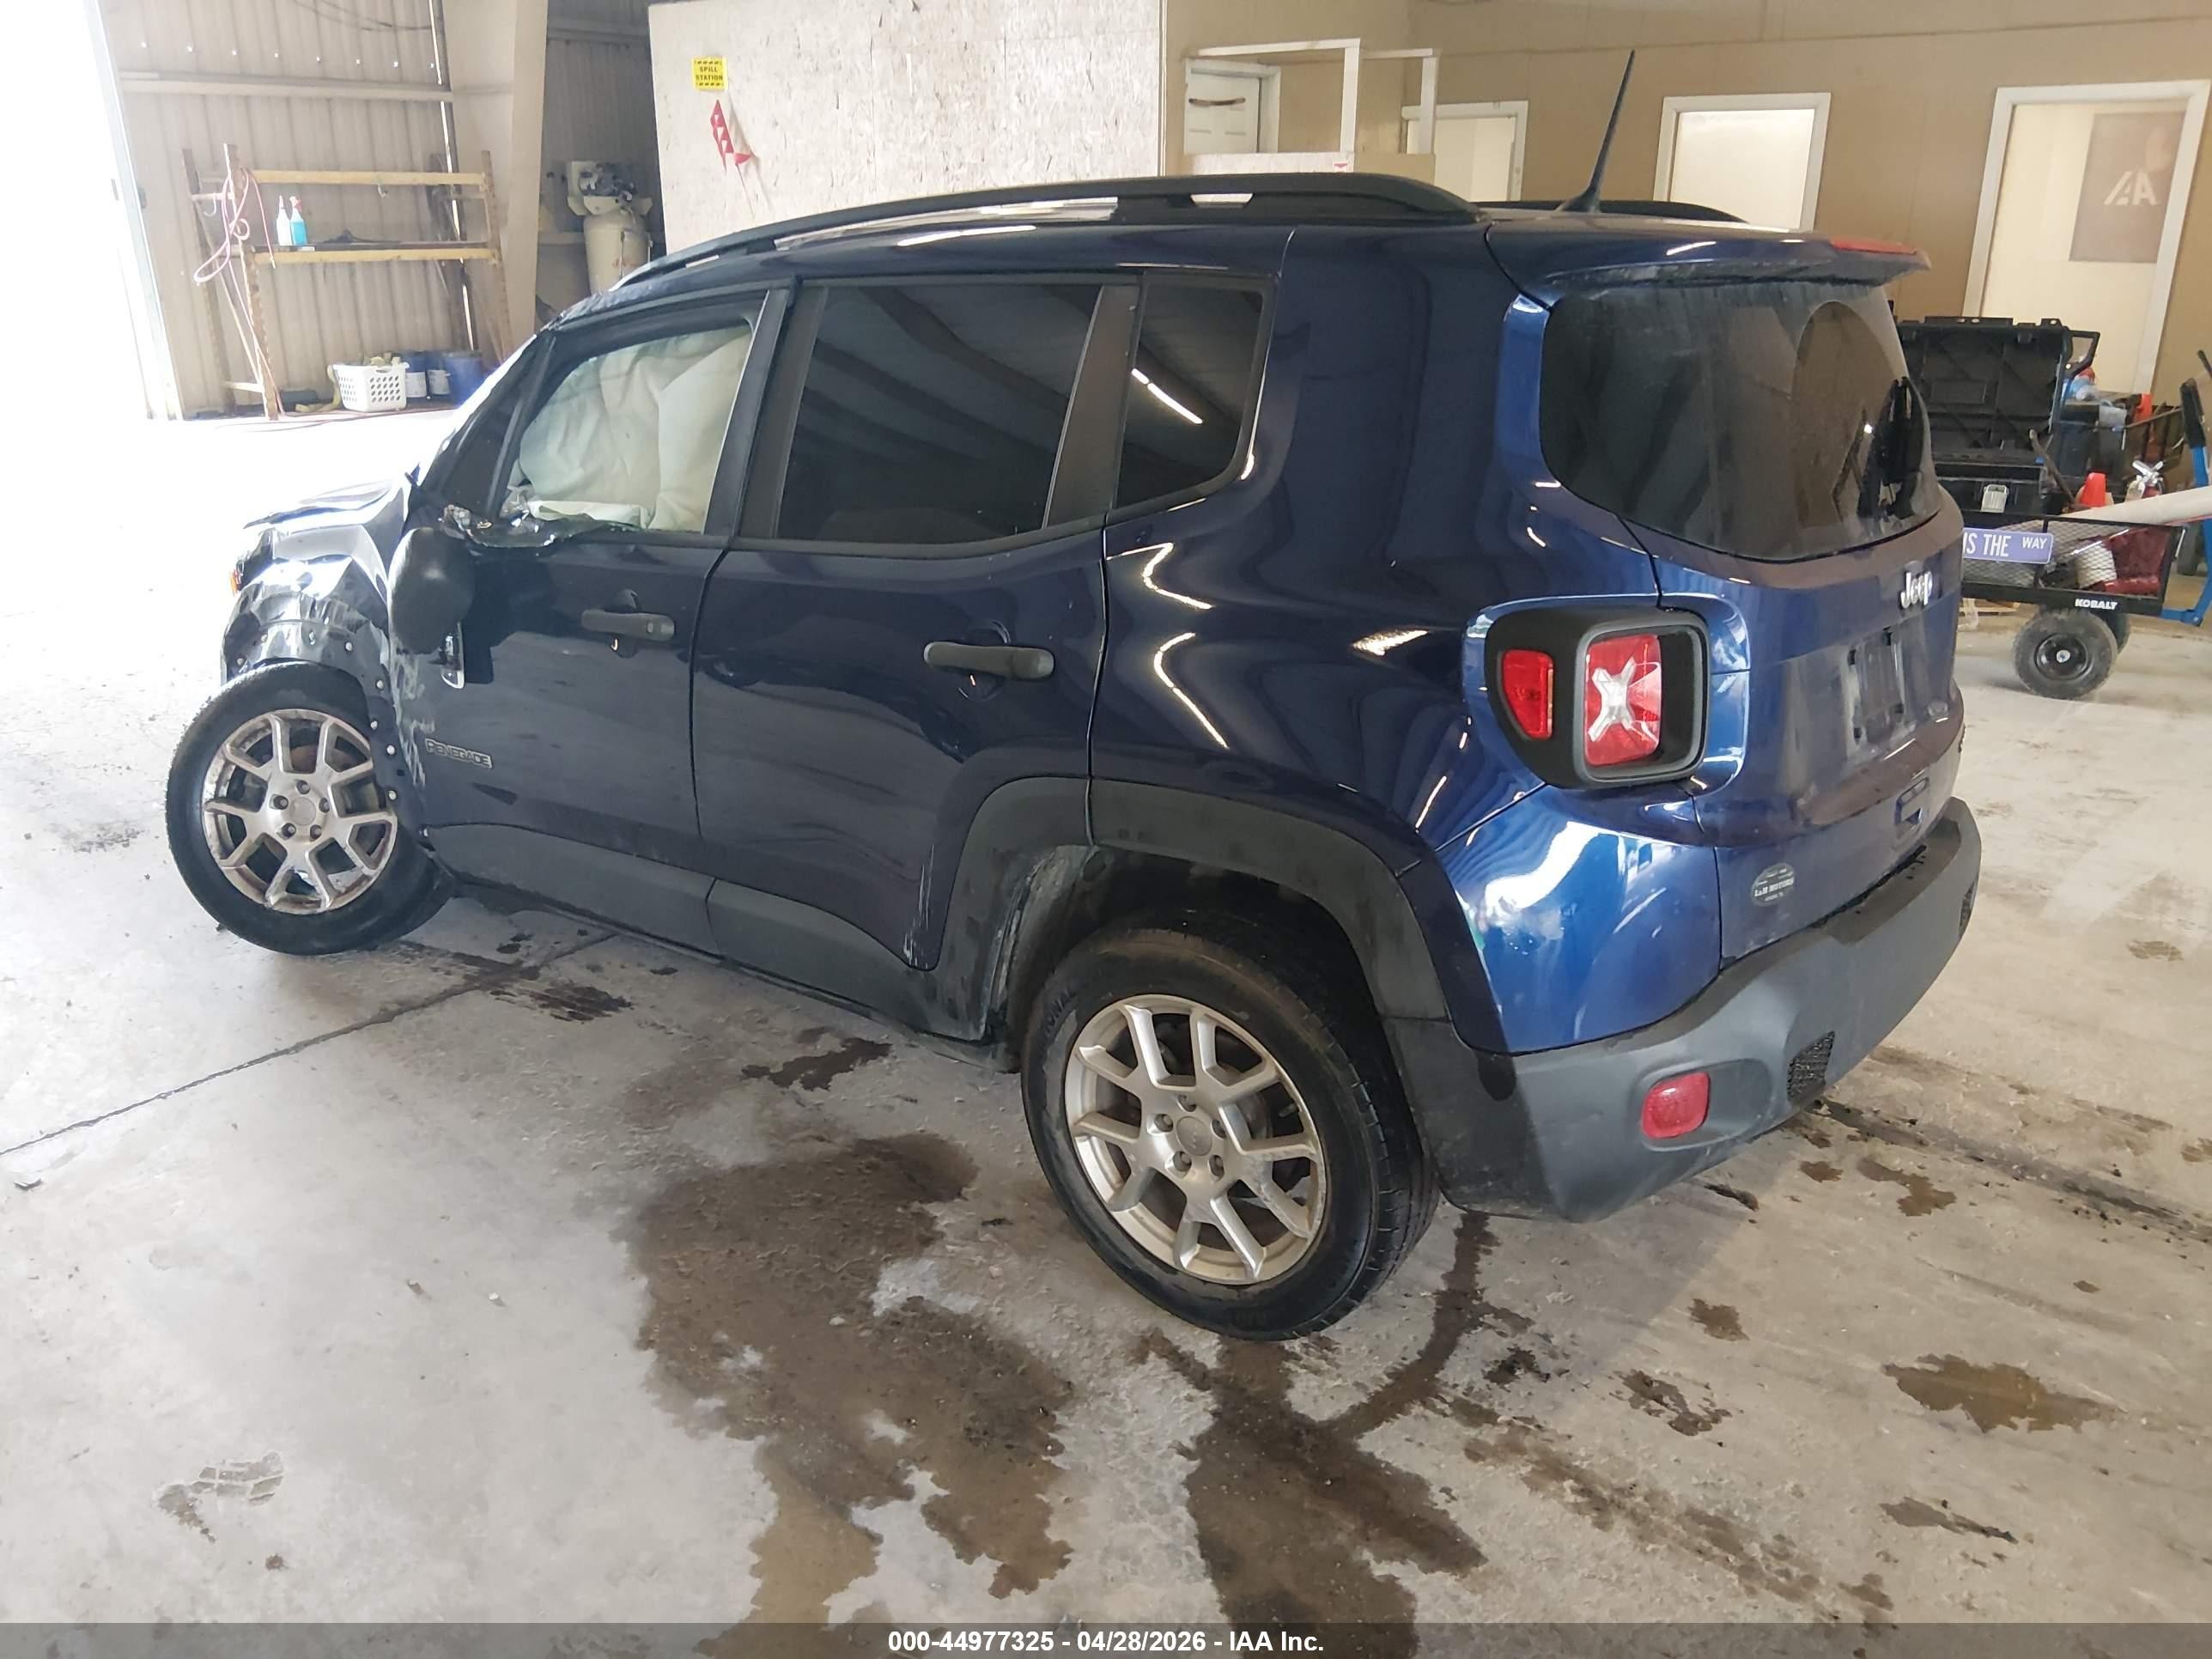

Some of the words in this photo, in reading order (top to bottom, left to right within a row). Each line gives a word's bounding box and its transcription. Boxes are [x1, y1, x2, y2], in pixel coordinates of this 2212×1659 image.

[1984, 533, 2012, 557] THE
[2022, 536, 2047, 550] WAY
[1900, 571, 1932, 609] Jeep
[2075, 599, 2118, 611] KOBALT
[425, 738, 492, 769] RENEGADE
